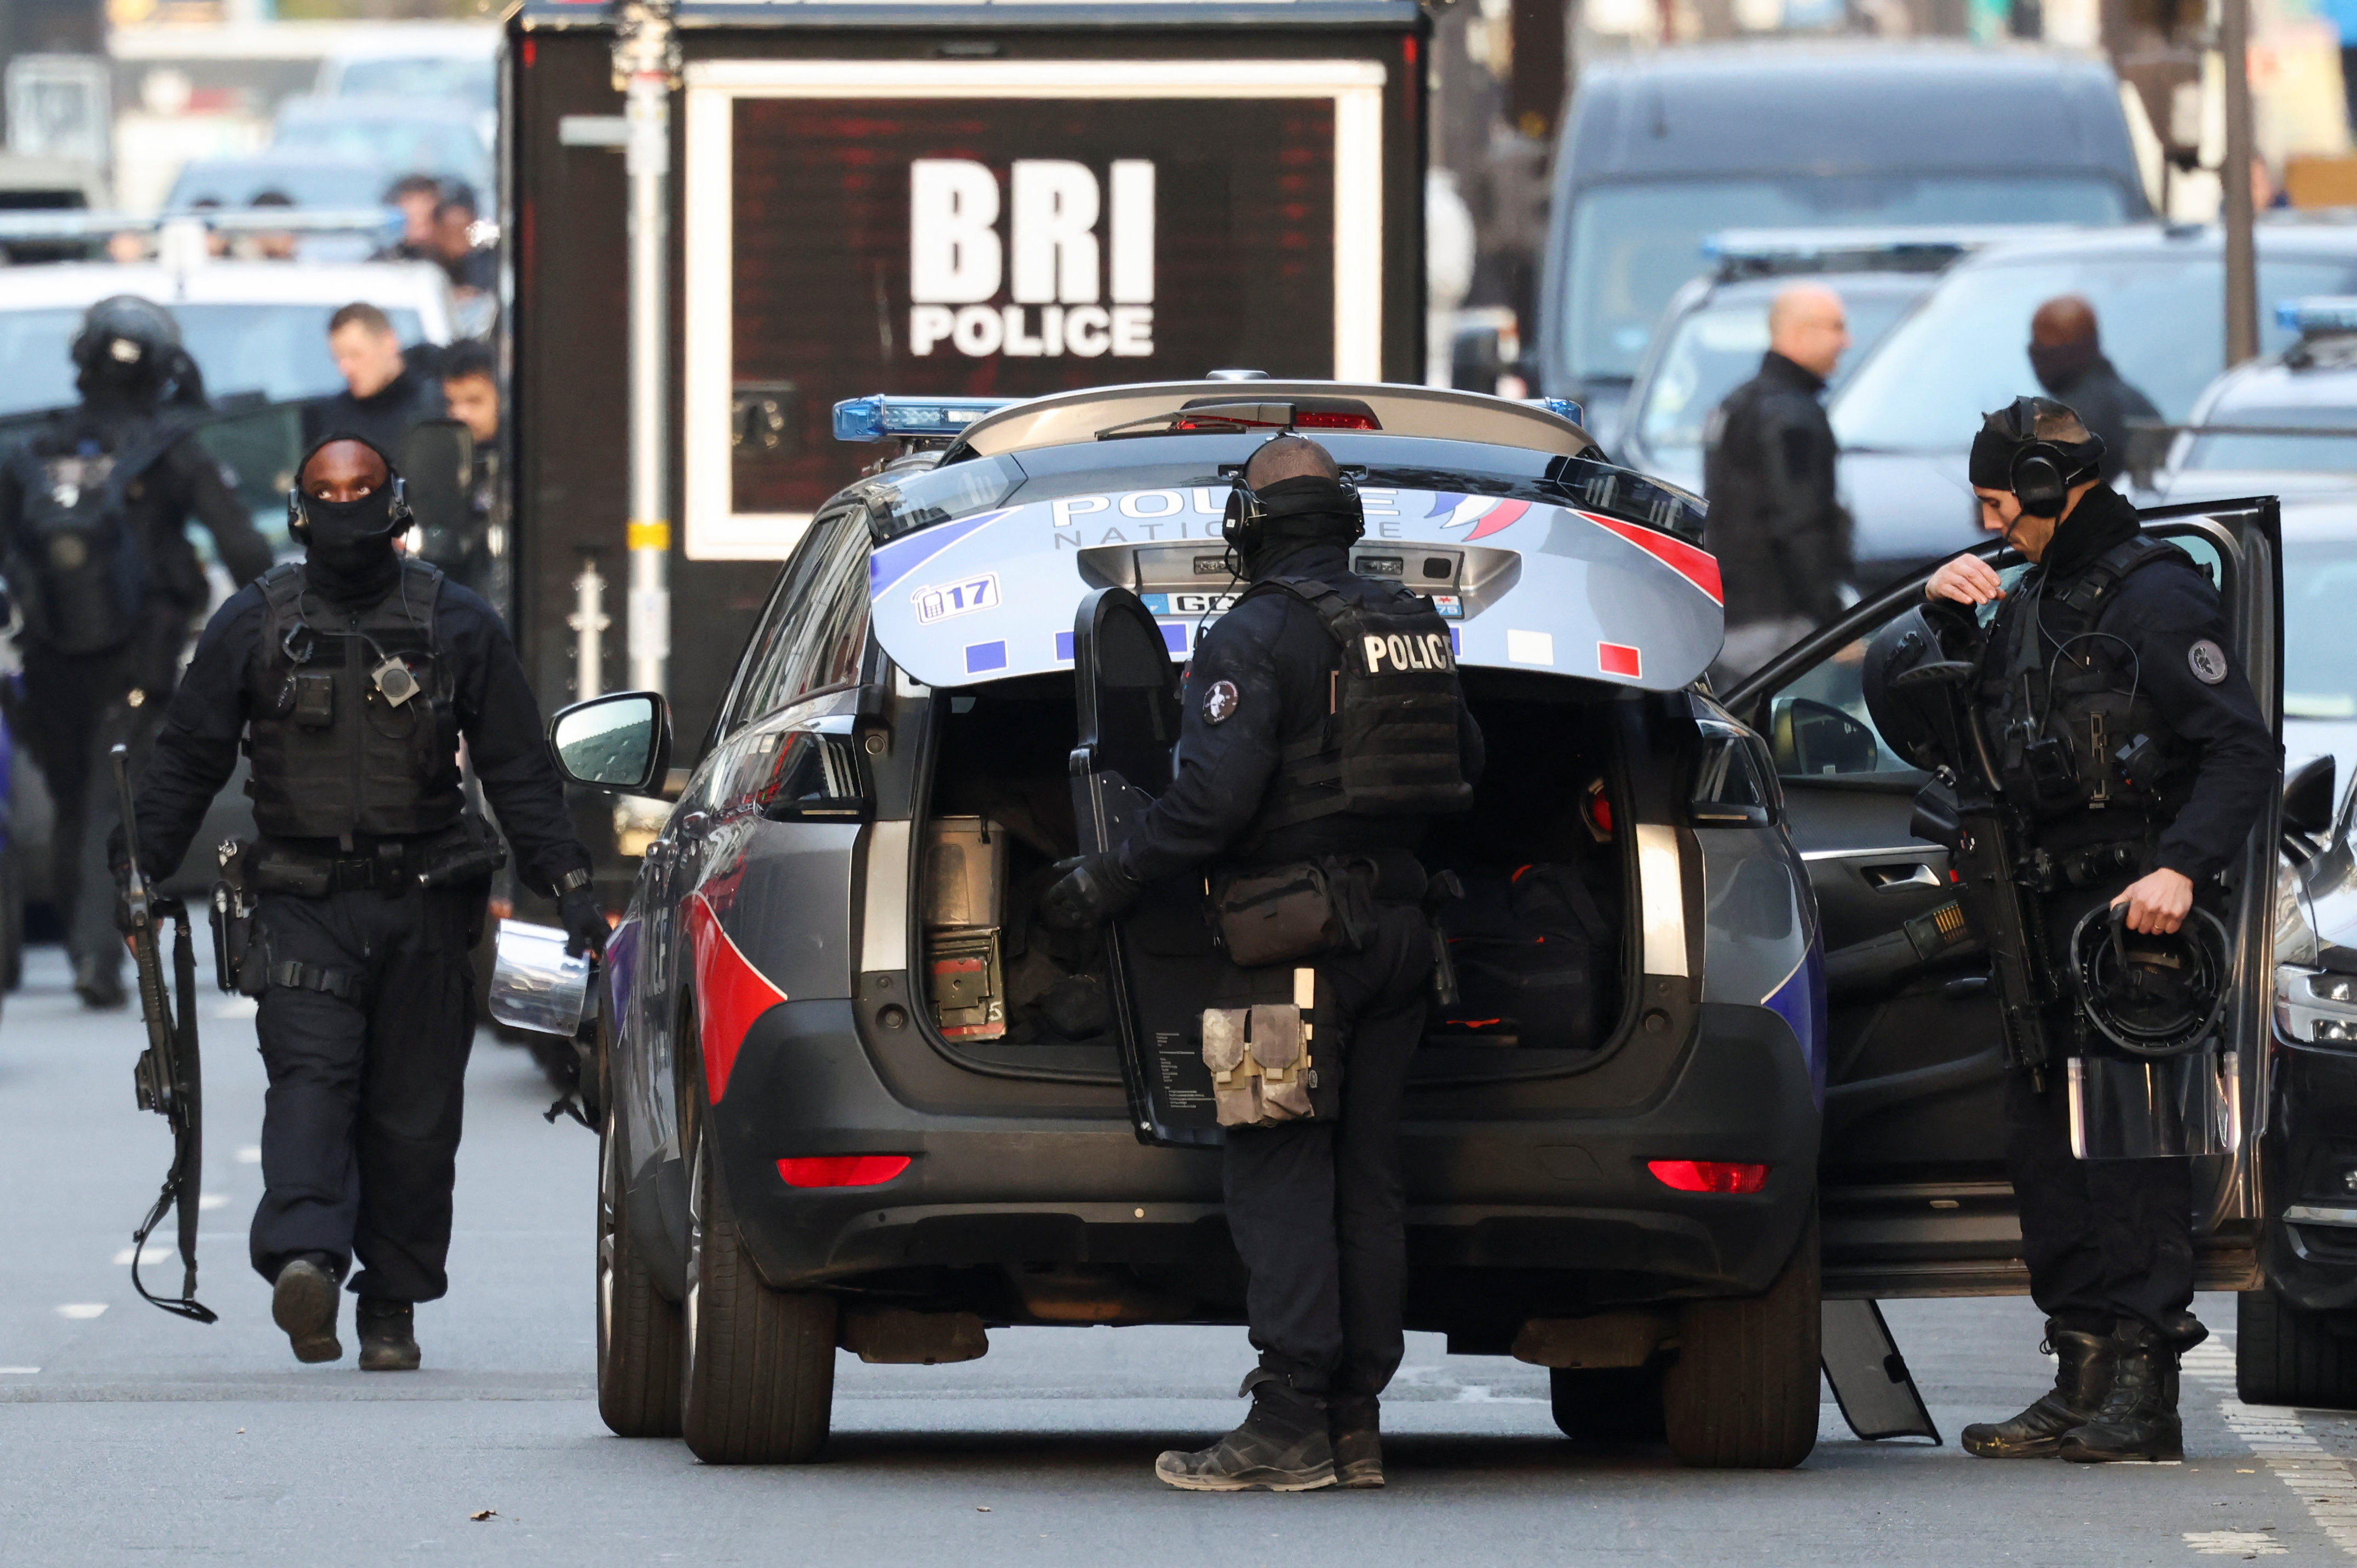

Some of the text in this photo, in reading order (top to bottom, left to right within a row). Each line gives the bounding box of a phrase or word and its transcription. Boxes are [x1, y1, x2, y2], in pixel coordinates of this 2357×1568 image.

[910, 158, 1154, 303] BRI
[910, 304, 1154, 356] POLICE
[1051, 487, 1400, 527] POLE
[946, 580, 990, 610] 17
[1437, 606, 1458, 614] 75
[988, 1001, 1003, 1021] 5
